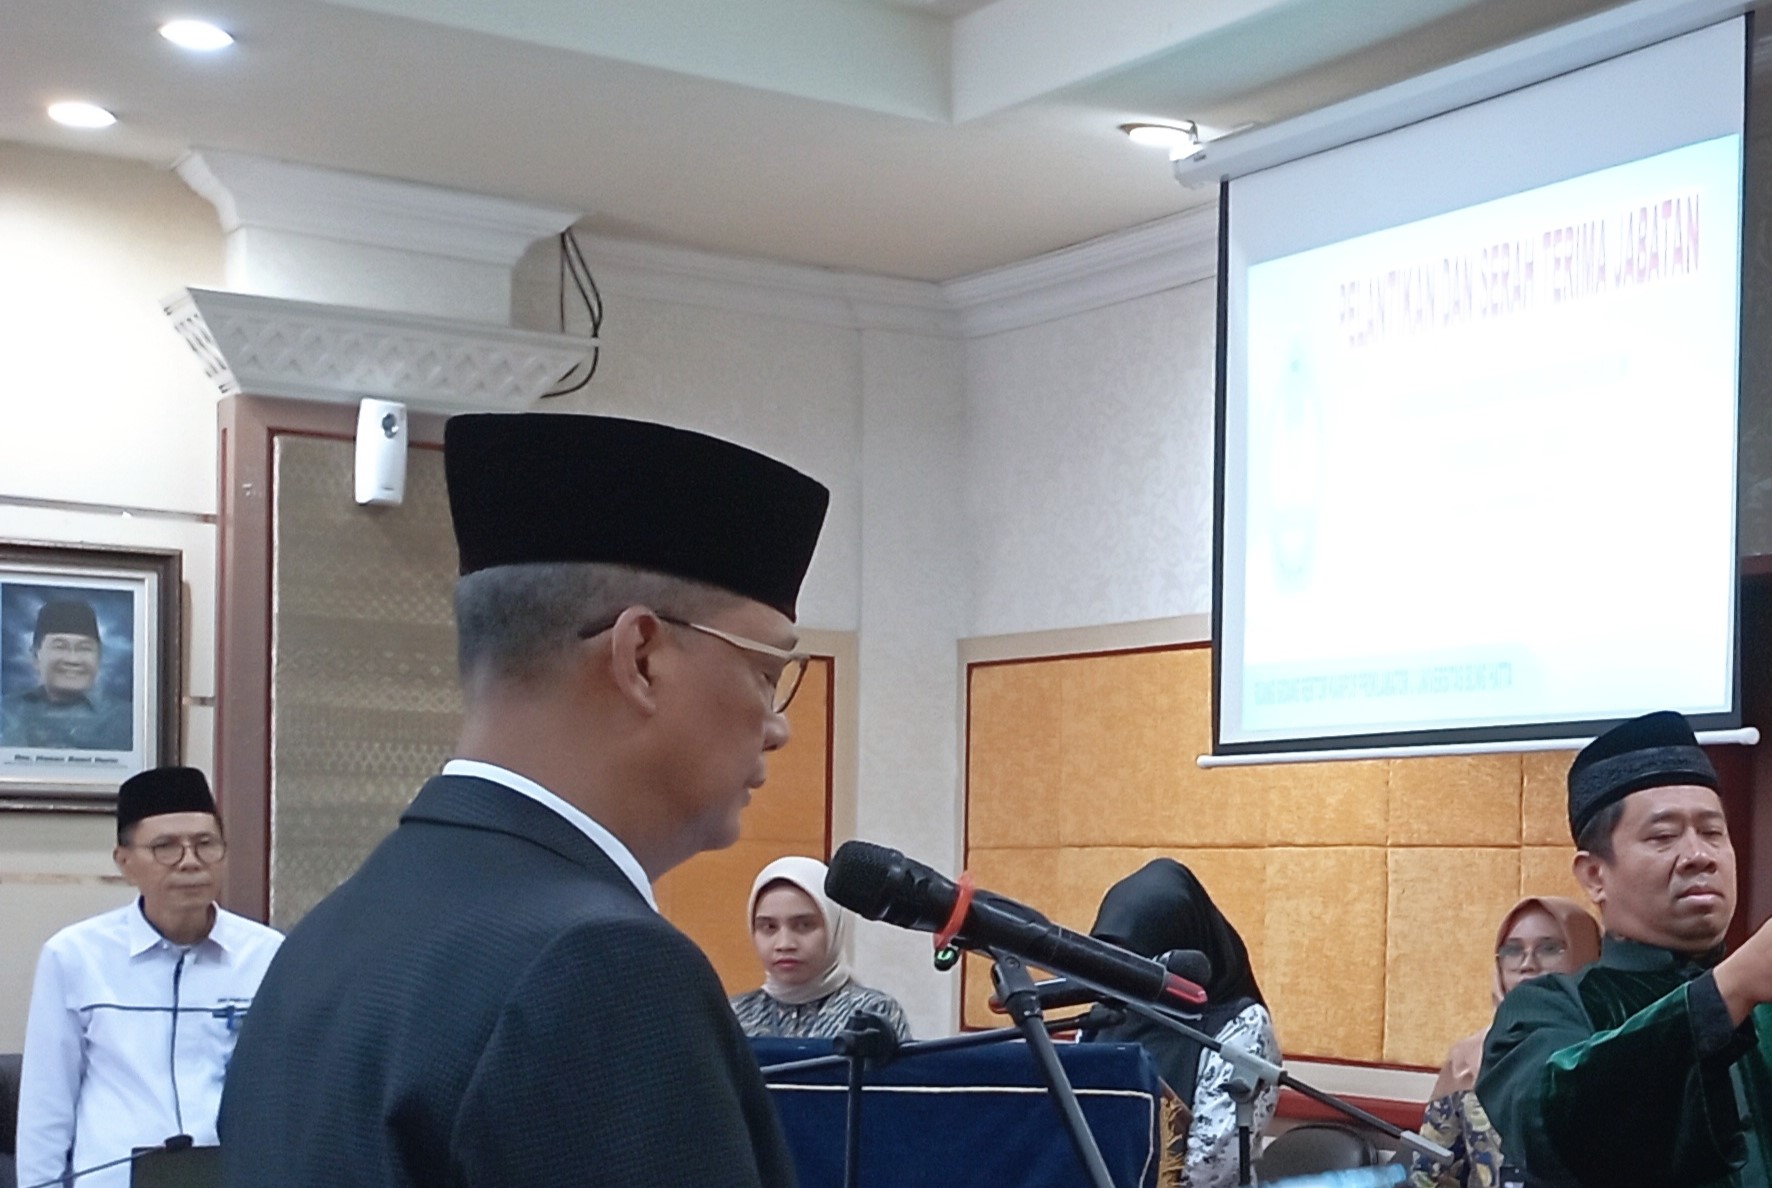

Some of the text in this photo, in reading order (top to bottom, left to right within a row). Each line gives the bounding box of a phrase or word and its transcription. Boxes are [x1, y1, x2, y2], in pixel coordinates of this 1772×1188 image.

[1442, 255, 1473, 328] DAN
[1481, 240, 1535, 318] SERAH
[1542, 218, 1607, 303] TERIMA
[1614, 193, 1700, 288] JABATAN
